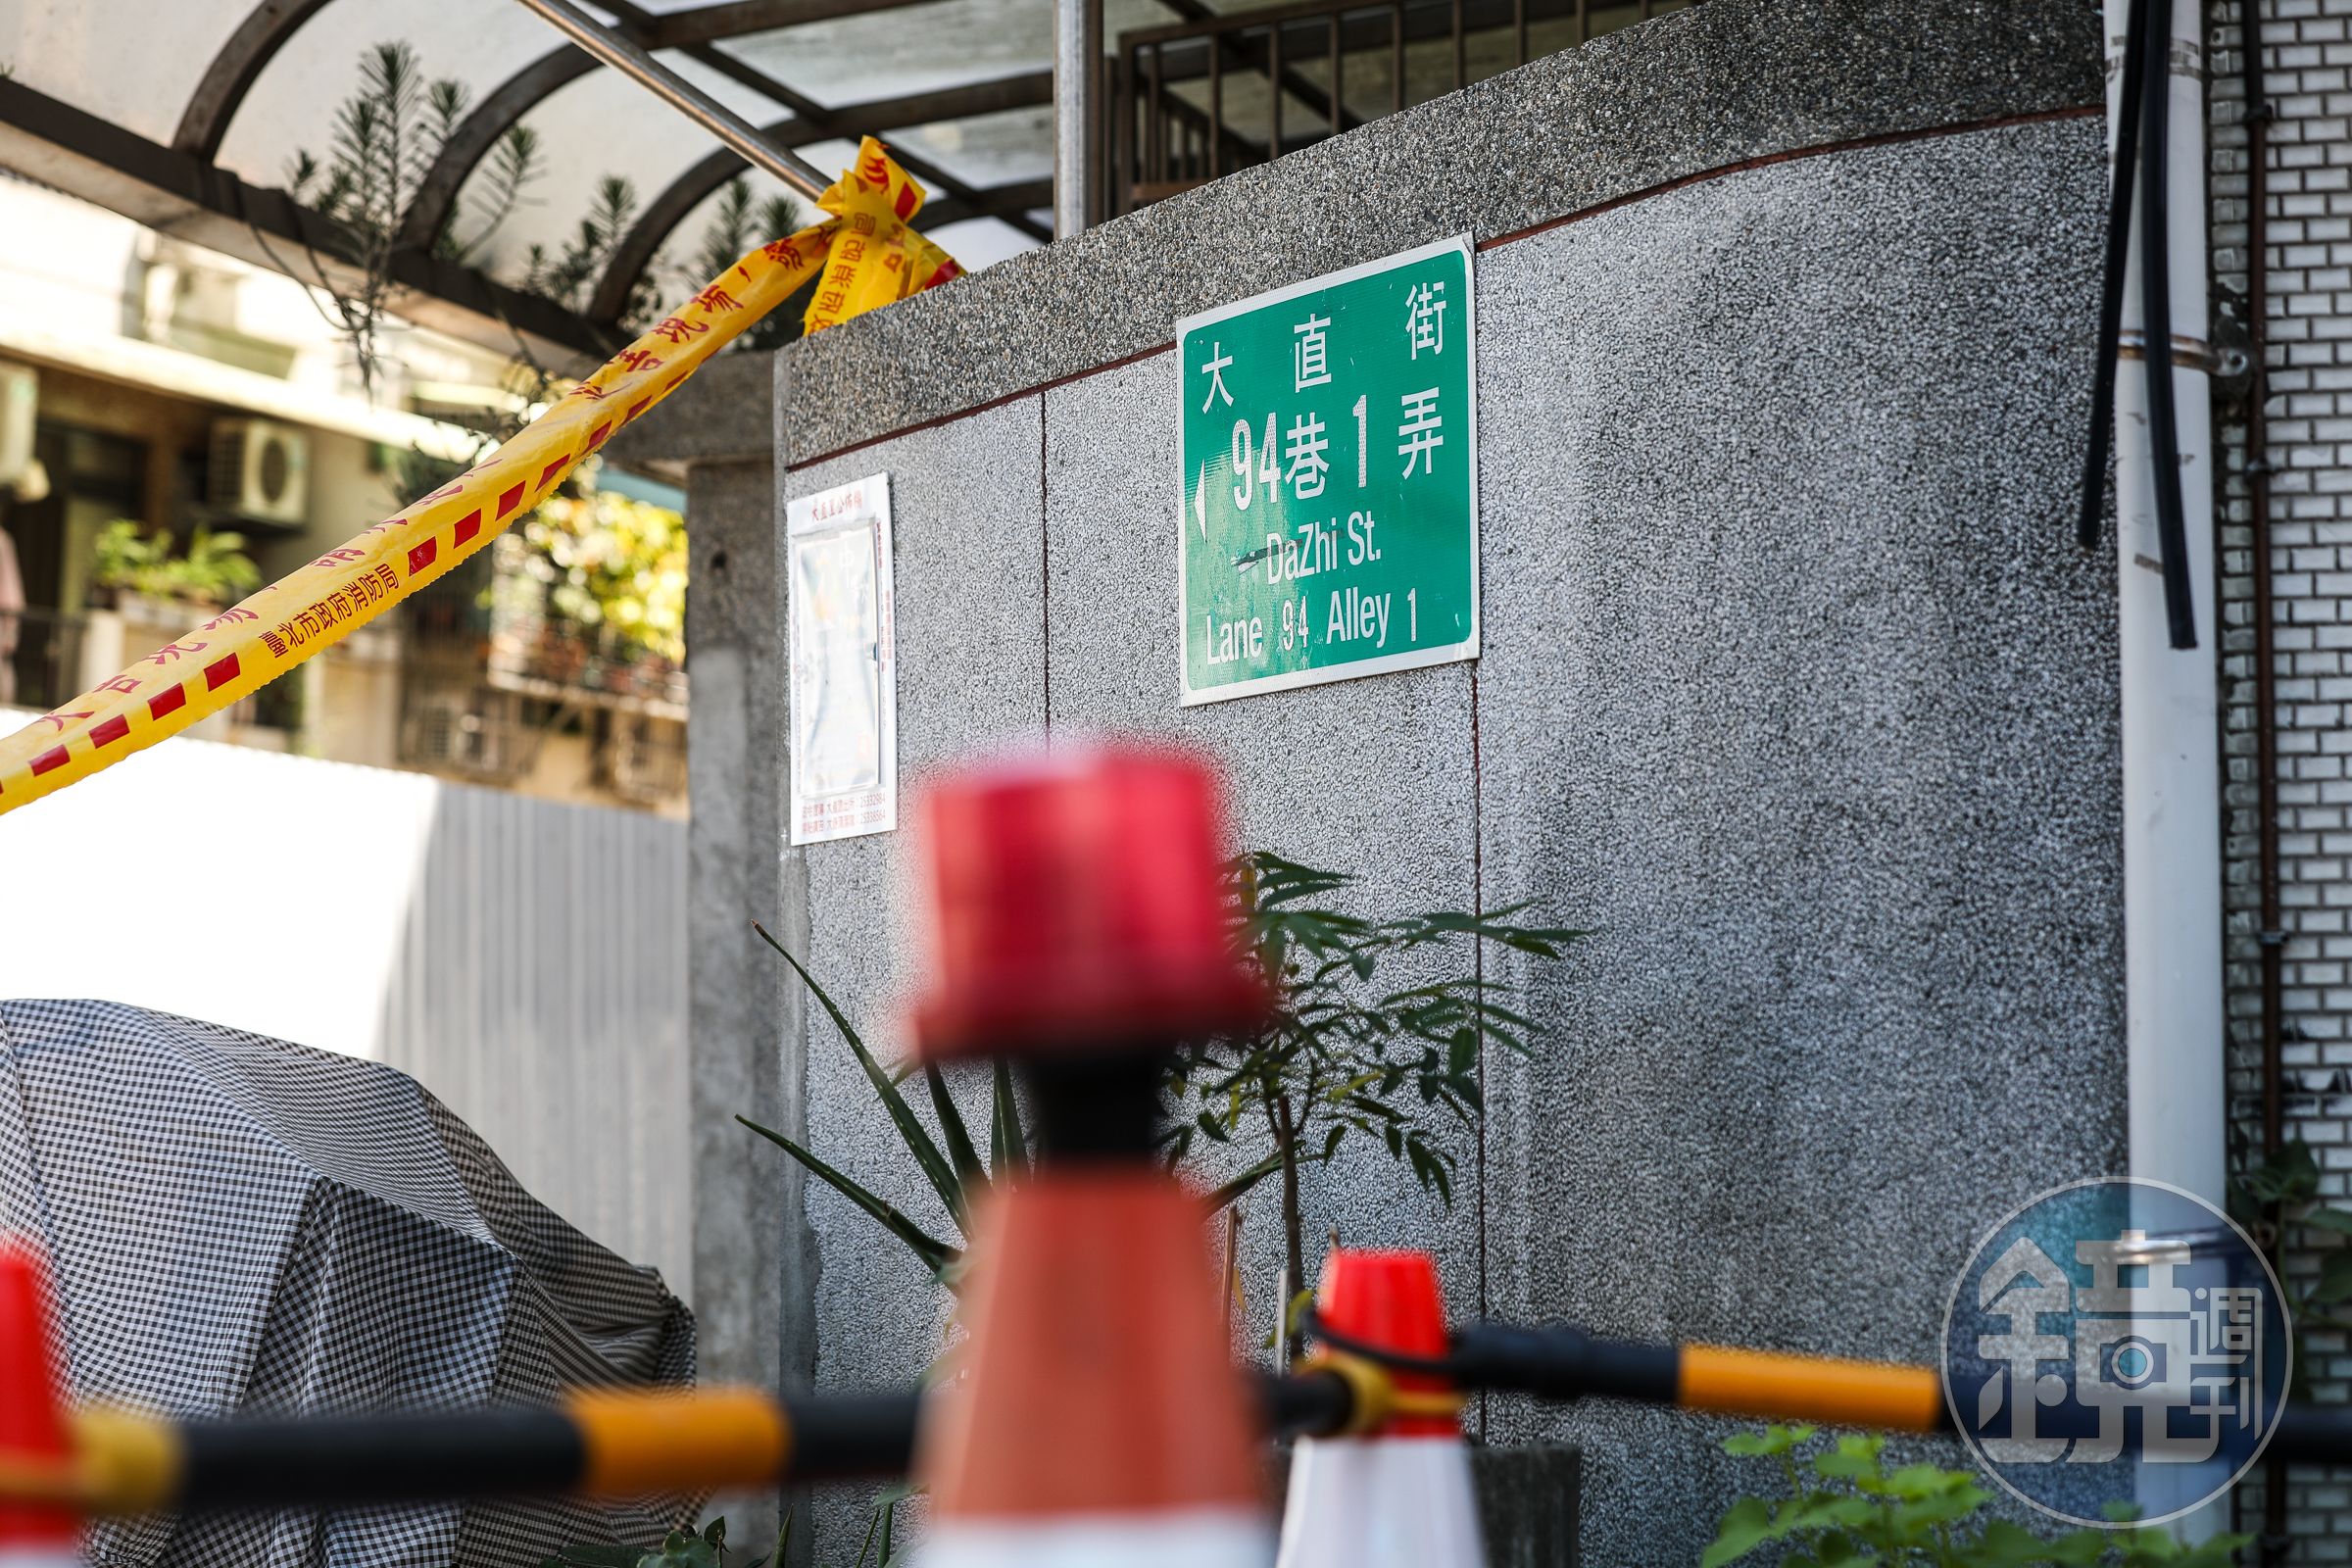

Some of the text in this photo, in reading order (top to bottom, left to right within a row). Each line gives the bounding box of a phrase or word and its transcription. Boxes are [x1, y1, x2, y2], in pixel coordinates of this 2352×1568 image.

[1201, 281, 1447, 415] 大直街
[1266, 511, 1381, 585] DaZhi St.
[259, 563, 400, 659] 臺北市政府消防局
[1206, 586, 1417, 665] Lane 94 Alley 1
